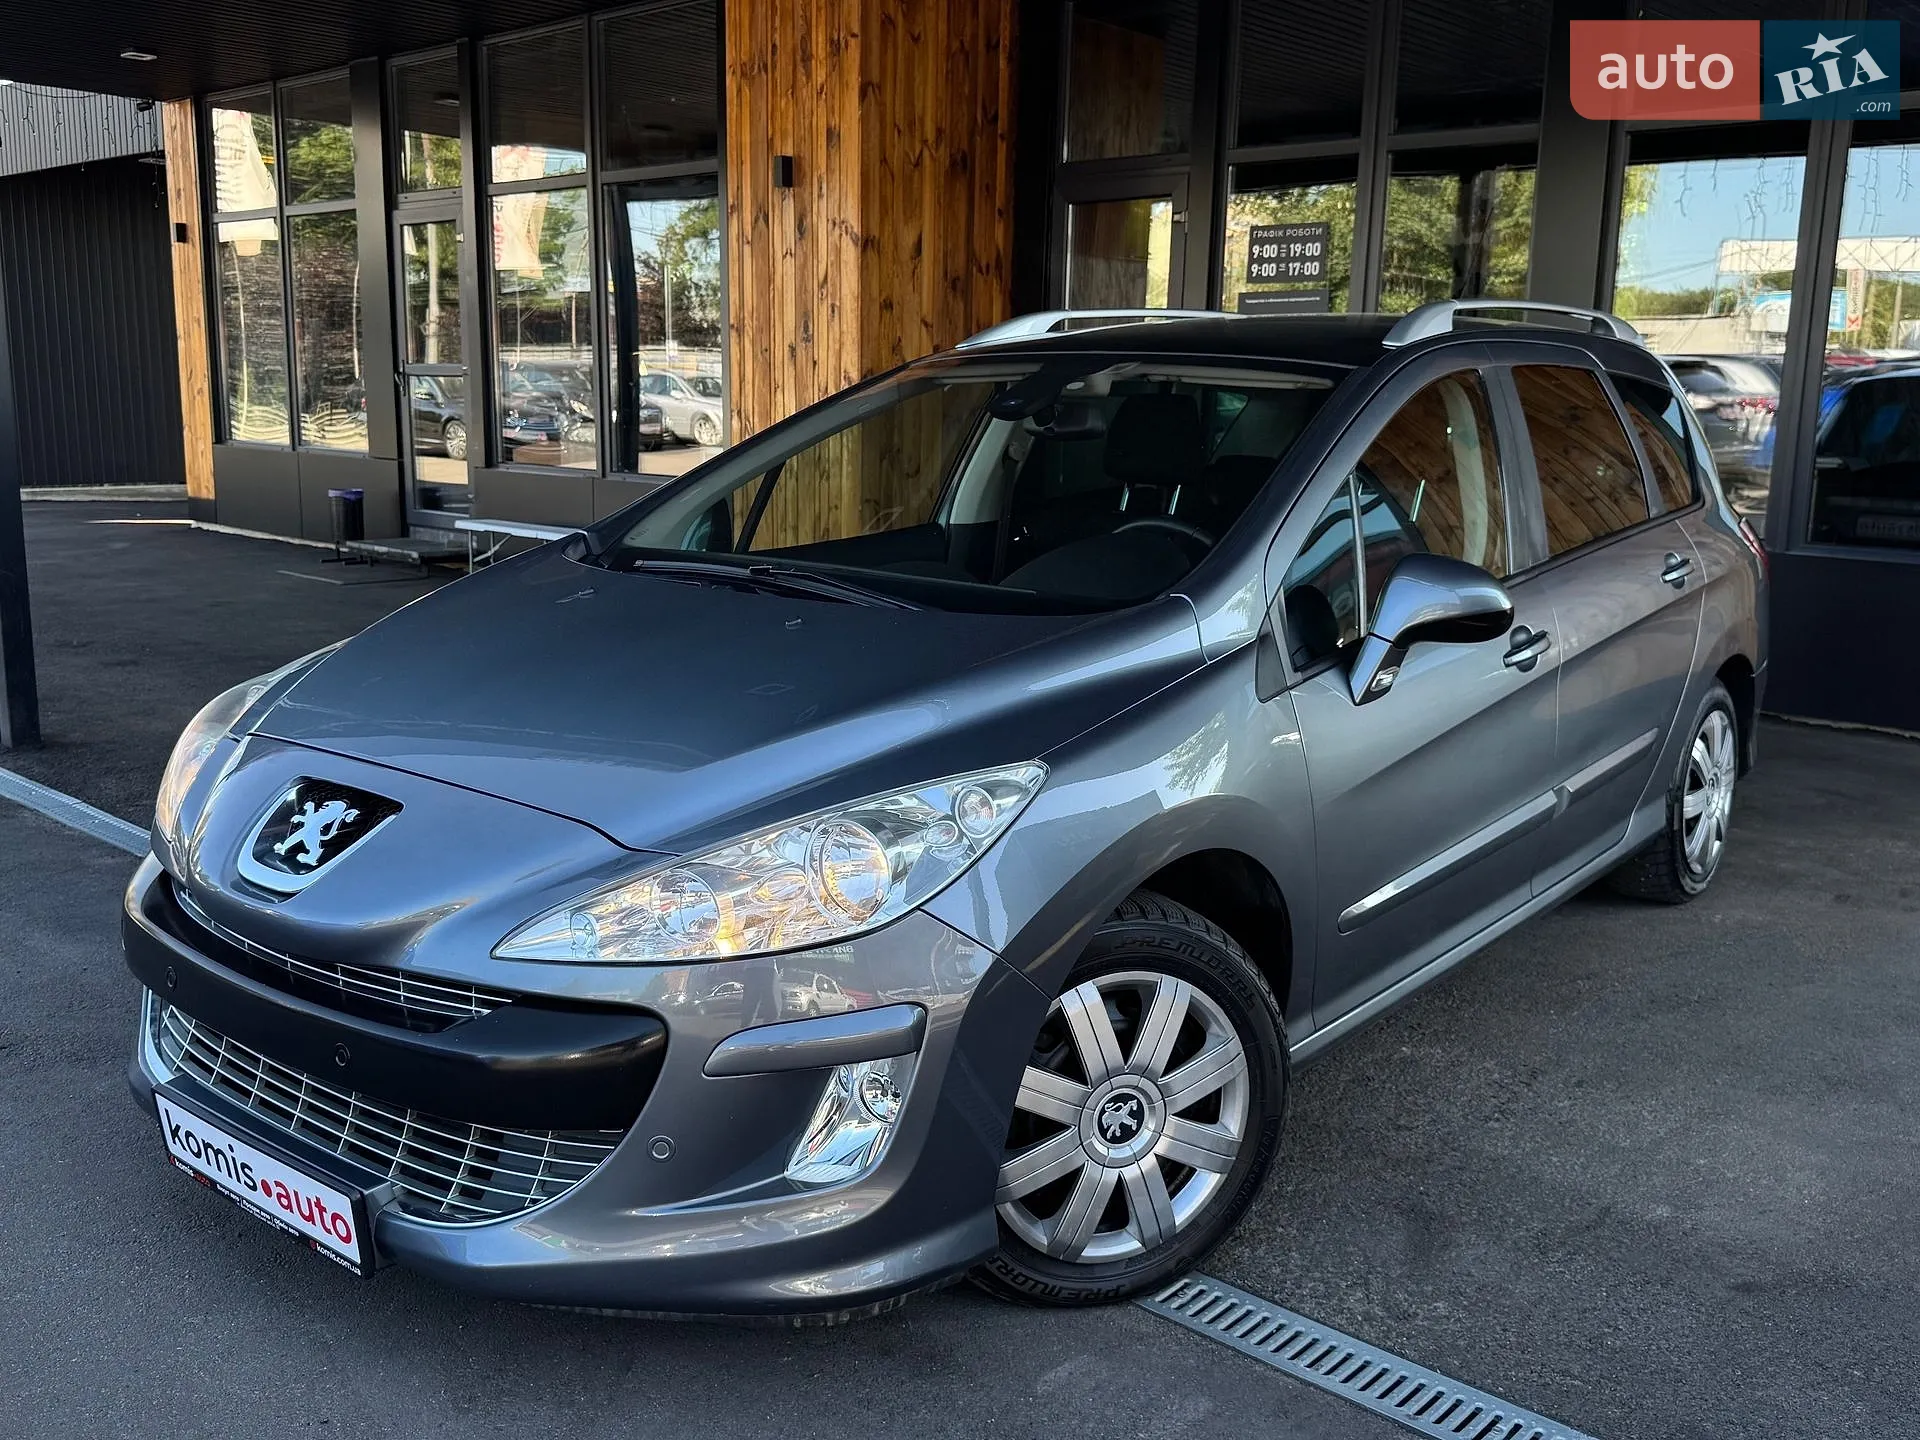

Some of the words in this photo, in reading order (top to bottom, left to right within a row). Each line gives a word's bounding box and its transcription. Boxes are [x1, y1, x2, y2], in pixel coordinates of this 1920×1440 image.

[1252, 230, 1284, 239] ГРАФІК
[1286, 227, 1322, 237] РОБОТИ
[1252, 244, 1278, 259] 9:00
[1289, 242, 1321, 257] 19:00
[1251, 263, 1277, 277] 9:00
[1288, 261, 1320, 276] 17:00
